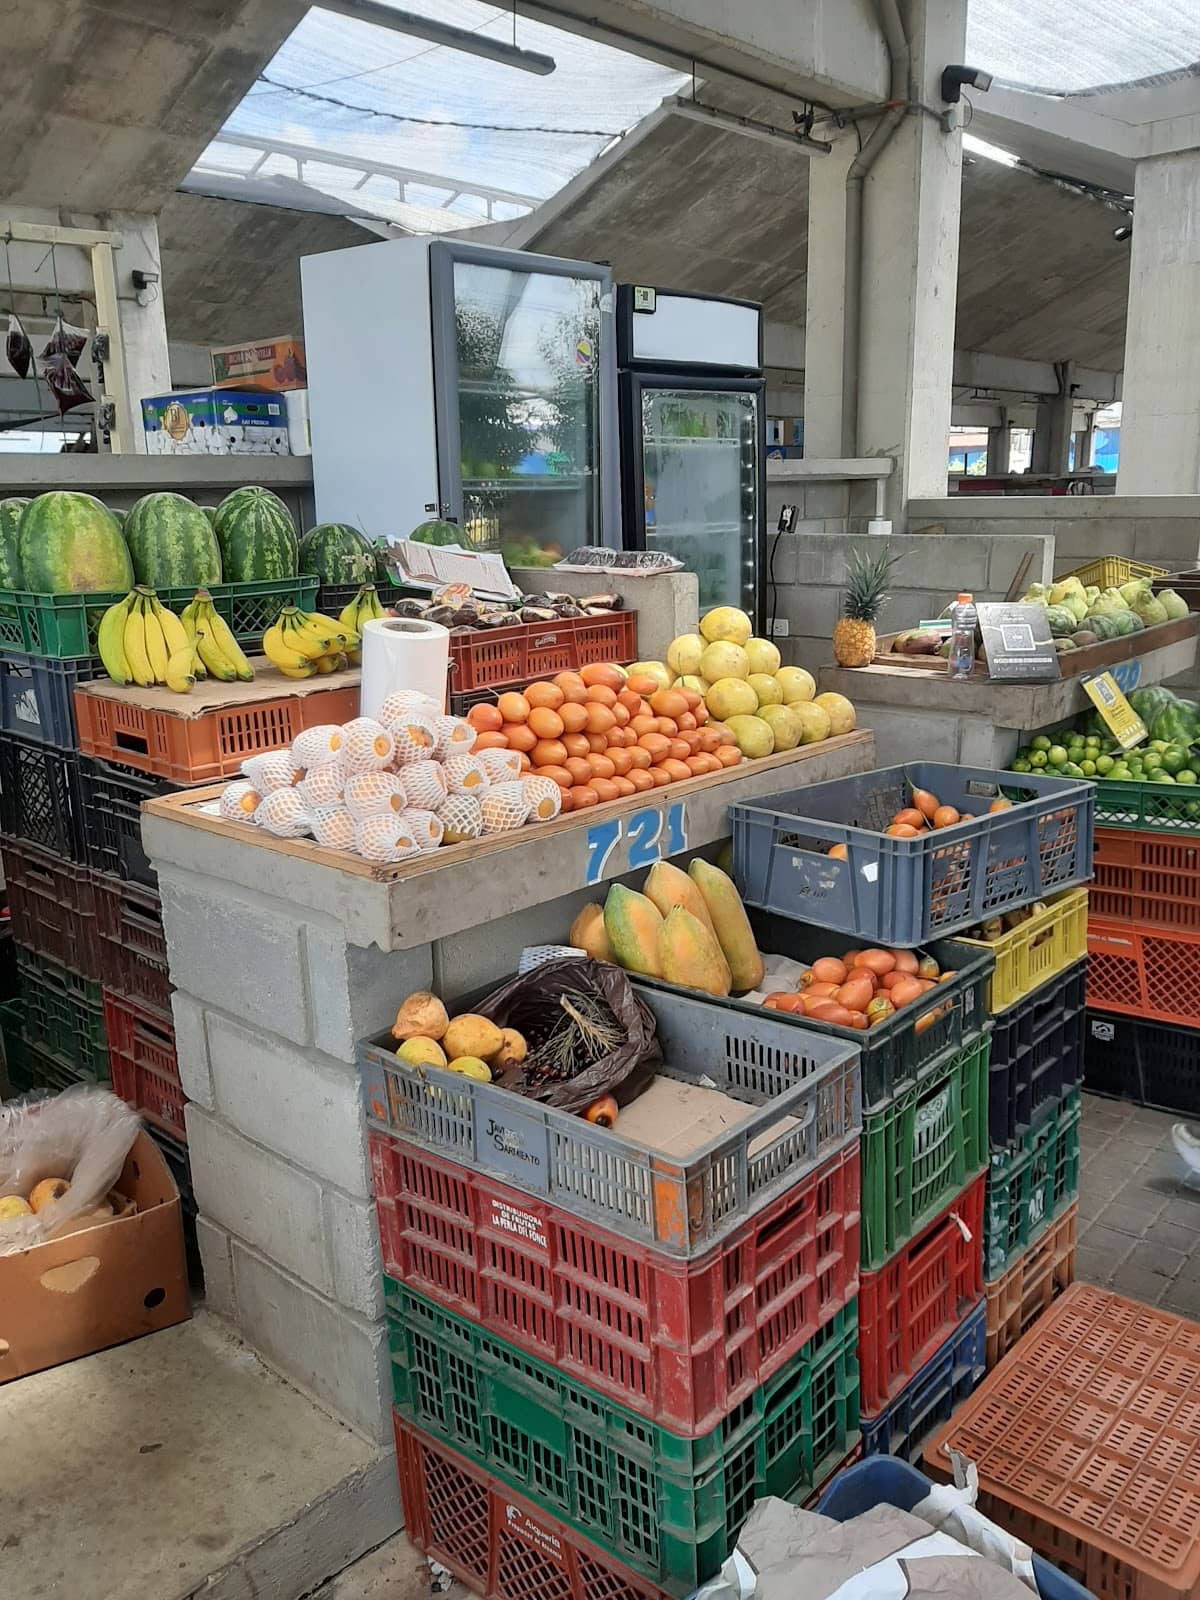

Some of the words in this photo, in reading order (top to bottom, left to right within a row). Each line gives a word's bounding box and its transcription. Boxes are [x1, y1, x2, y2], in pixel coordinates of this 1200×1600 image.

[1109, 661, 1141, 694] 20
[586, 803, 688, 885] 721
[492, 1199, 543, 1227] DISTRIBUIDORA
[501, 1210, 511, 1221] DE
[511, 1214, 537, 1231] FRUTAS
